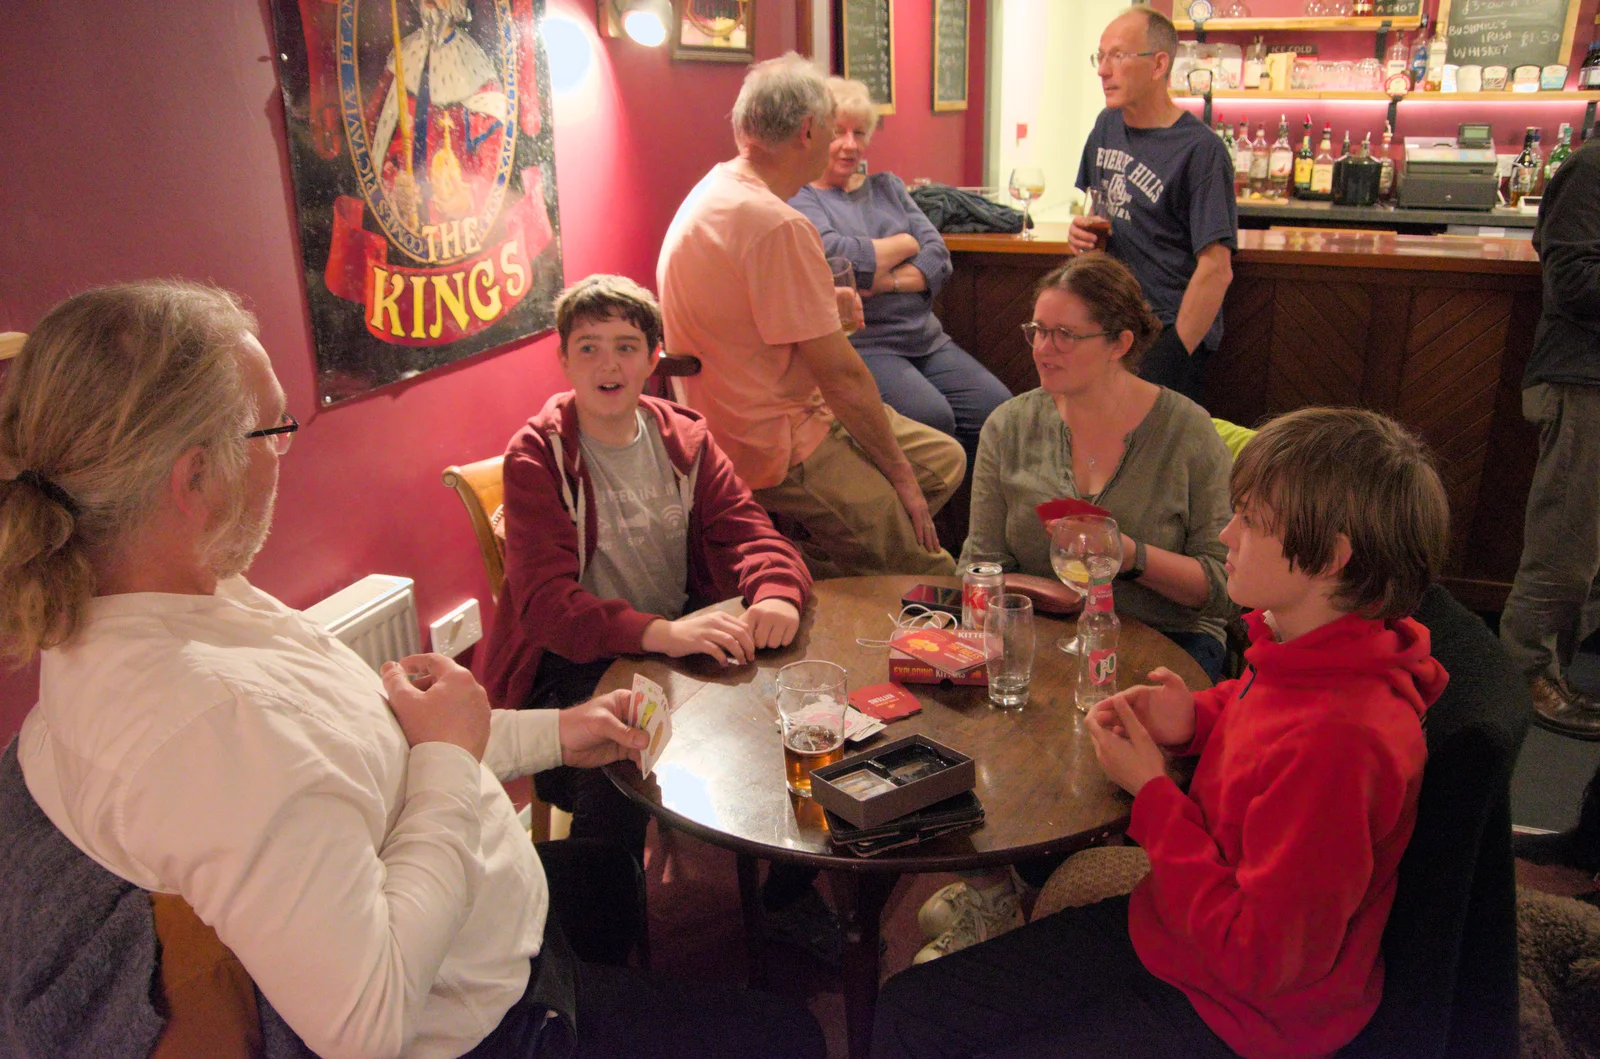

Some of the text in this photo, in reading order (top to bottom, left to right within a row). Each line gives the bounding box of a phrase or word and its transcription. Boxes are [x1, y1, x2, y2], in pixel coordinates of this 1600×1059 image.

[340, 34, 352, 66] ET
[1453, 44, 1508, 59] WHISKEY
[1481, 30, 1512, 43] IRISH
[1127, 162, 1164, 204] HILLS
[375, 199, 424, 254] COMES
[421, 216, 482, 263] THE
[370, 240, 525, 339] KINGS
[957, 631, 985, 639] KITTE
[893, 666, 934, 677] EXPLODING
